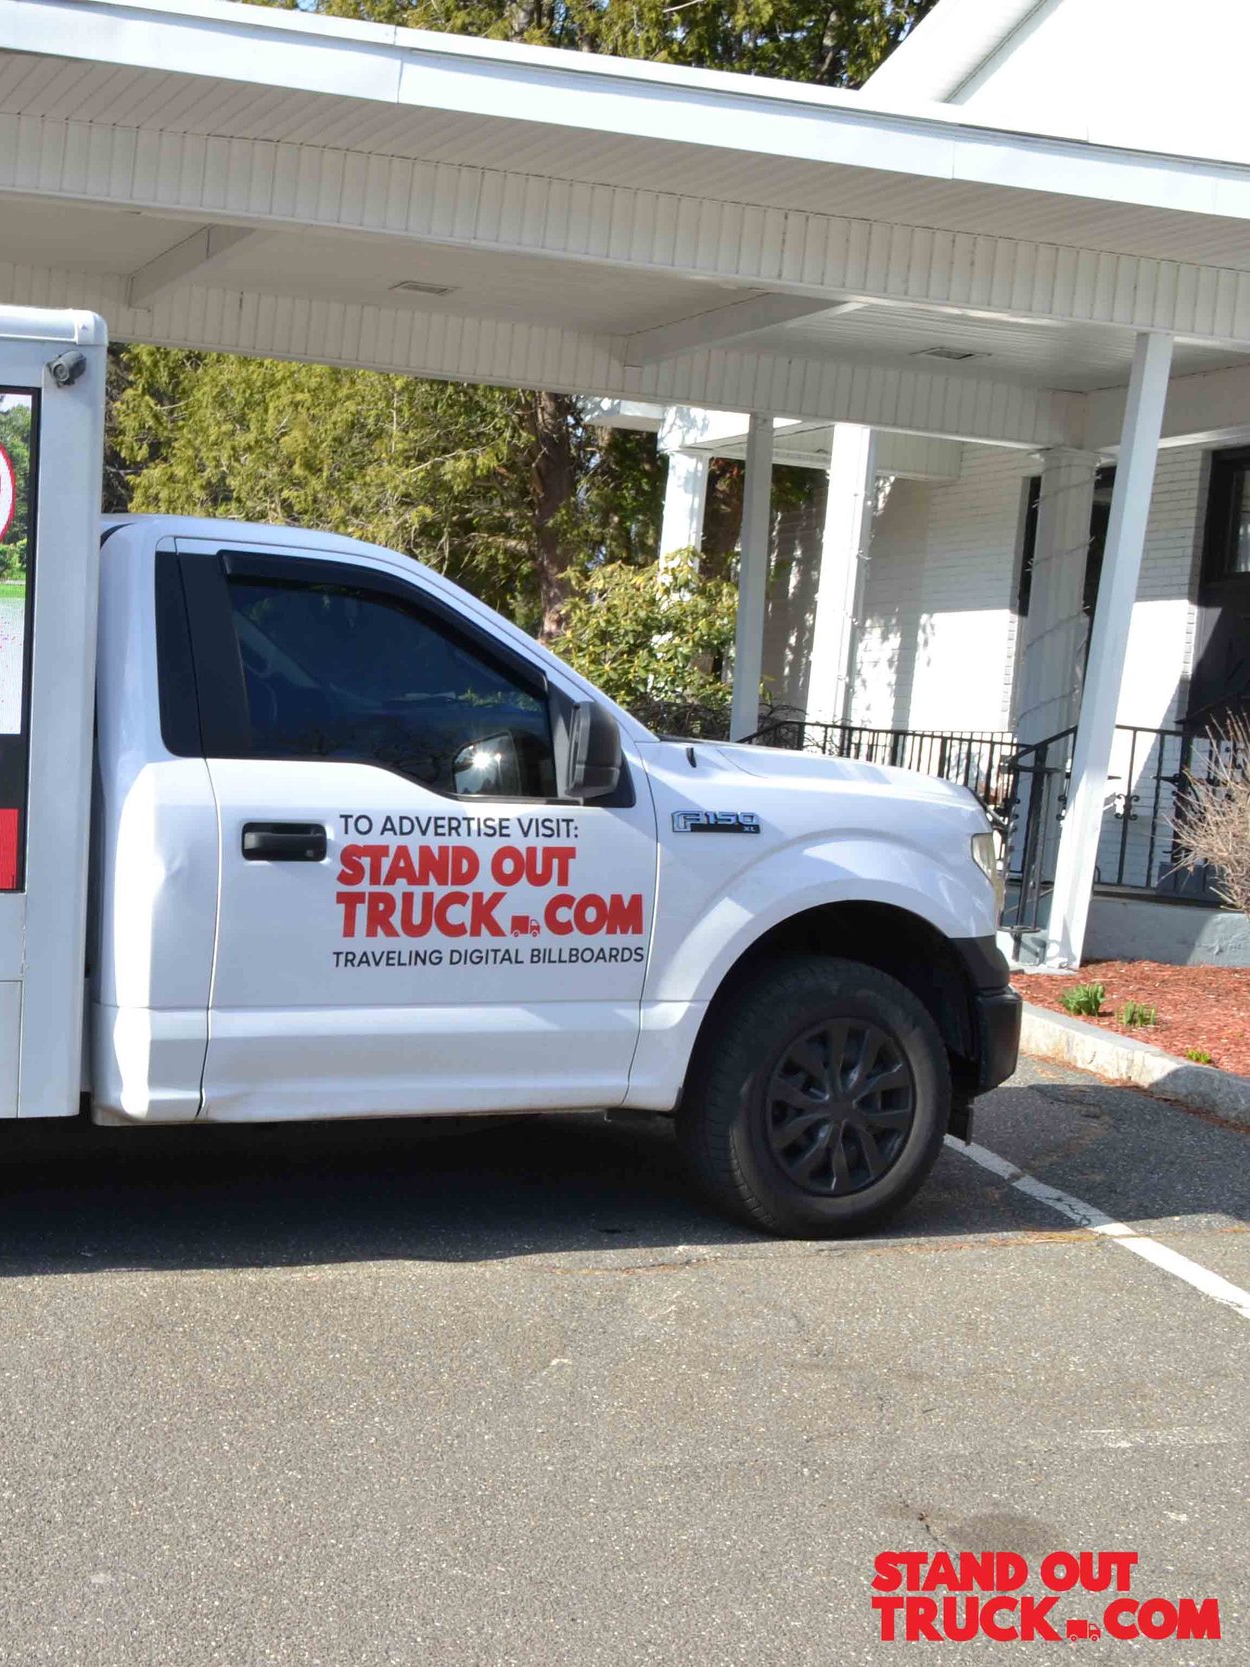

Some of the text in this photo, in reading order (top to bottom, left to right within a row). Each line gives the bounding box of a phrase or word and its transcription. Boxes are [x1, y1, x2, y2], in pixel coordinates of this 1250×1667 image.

[339, 814, 579, 838] TO ADVERTISE VISIT:
[336, 844, 577, 887] STAND OUT
[333, 947, 644, 967] TRAVELING DIGITAL BILLBOARDS
